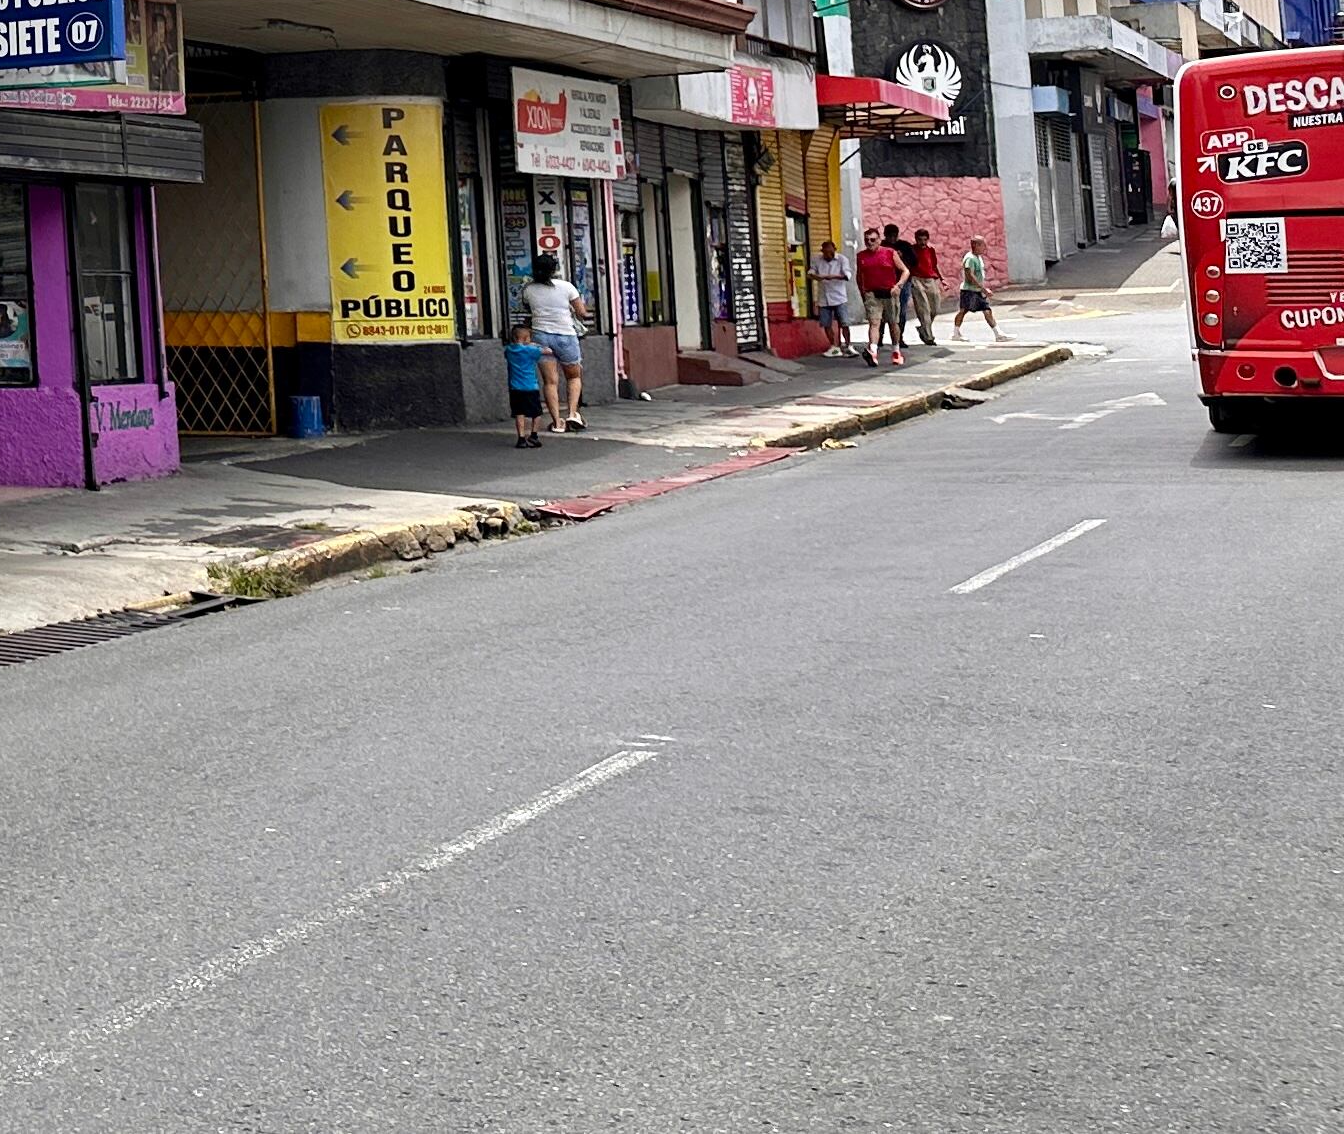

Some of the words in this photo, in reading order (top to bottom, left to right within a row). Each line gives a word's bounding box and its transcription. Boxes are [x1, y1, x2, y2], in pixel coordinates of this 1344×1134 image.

[71, 20, 98, 44] 07
[527, 106, 551, 130] XION
[1293, 112, 1343, 128] NUESTRA
[1207, 131, 1249, 150] APP
[1247, 142, 1265, 152] DE
[1225, 149, 1303, 180] KFC
[381, 107, 416, 293] PARQUEO
[1193, 197, 1220, 213] 437
[340, 295, 450, 318] PÚBLICO
